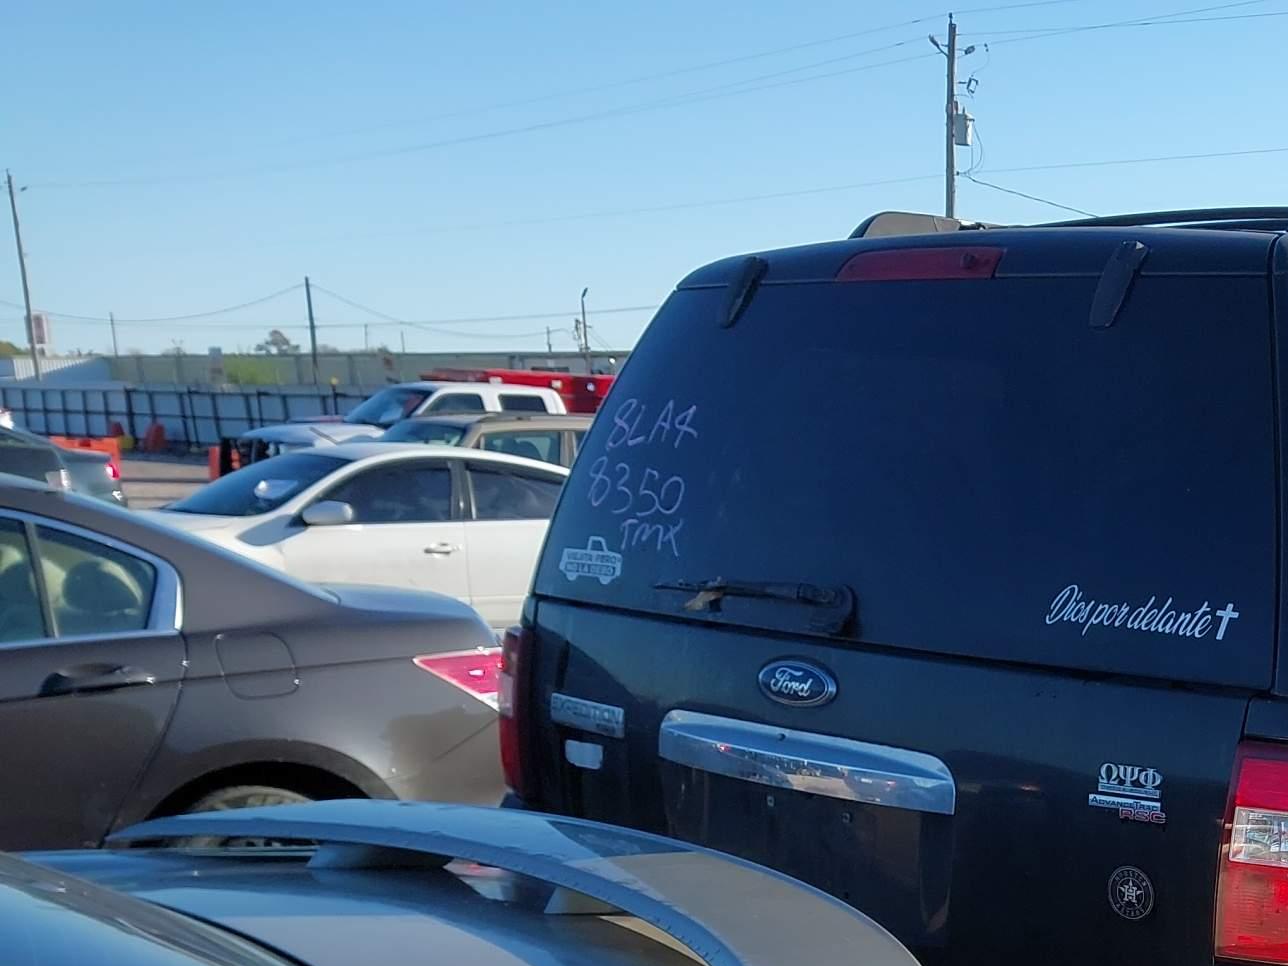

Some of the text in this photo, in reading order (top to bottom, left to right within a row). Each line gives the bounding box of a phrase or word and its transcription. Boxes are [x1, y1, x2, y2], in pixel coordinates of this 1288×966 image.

[587, 456, 685, 517] 8350
[1045, 584, 1213, 639] Dios por delante
[770, 667, 814, 697] Ford
[1119, 806, 1167, 824] RSC
